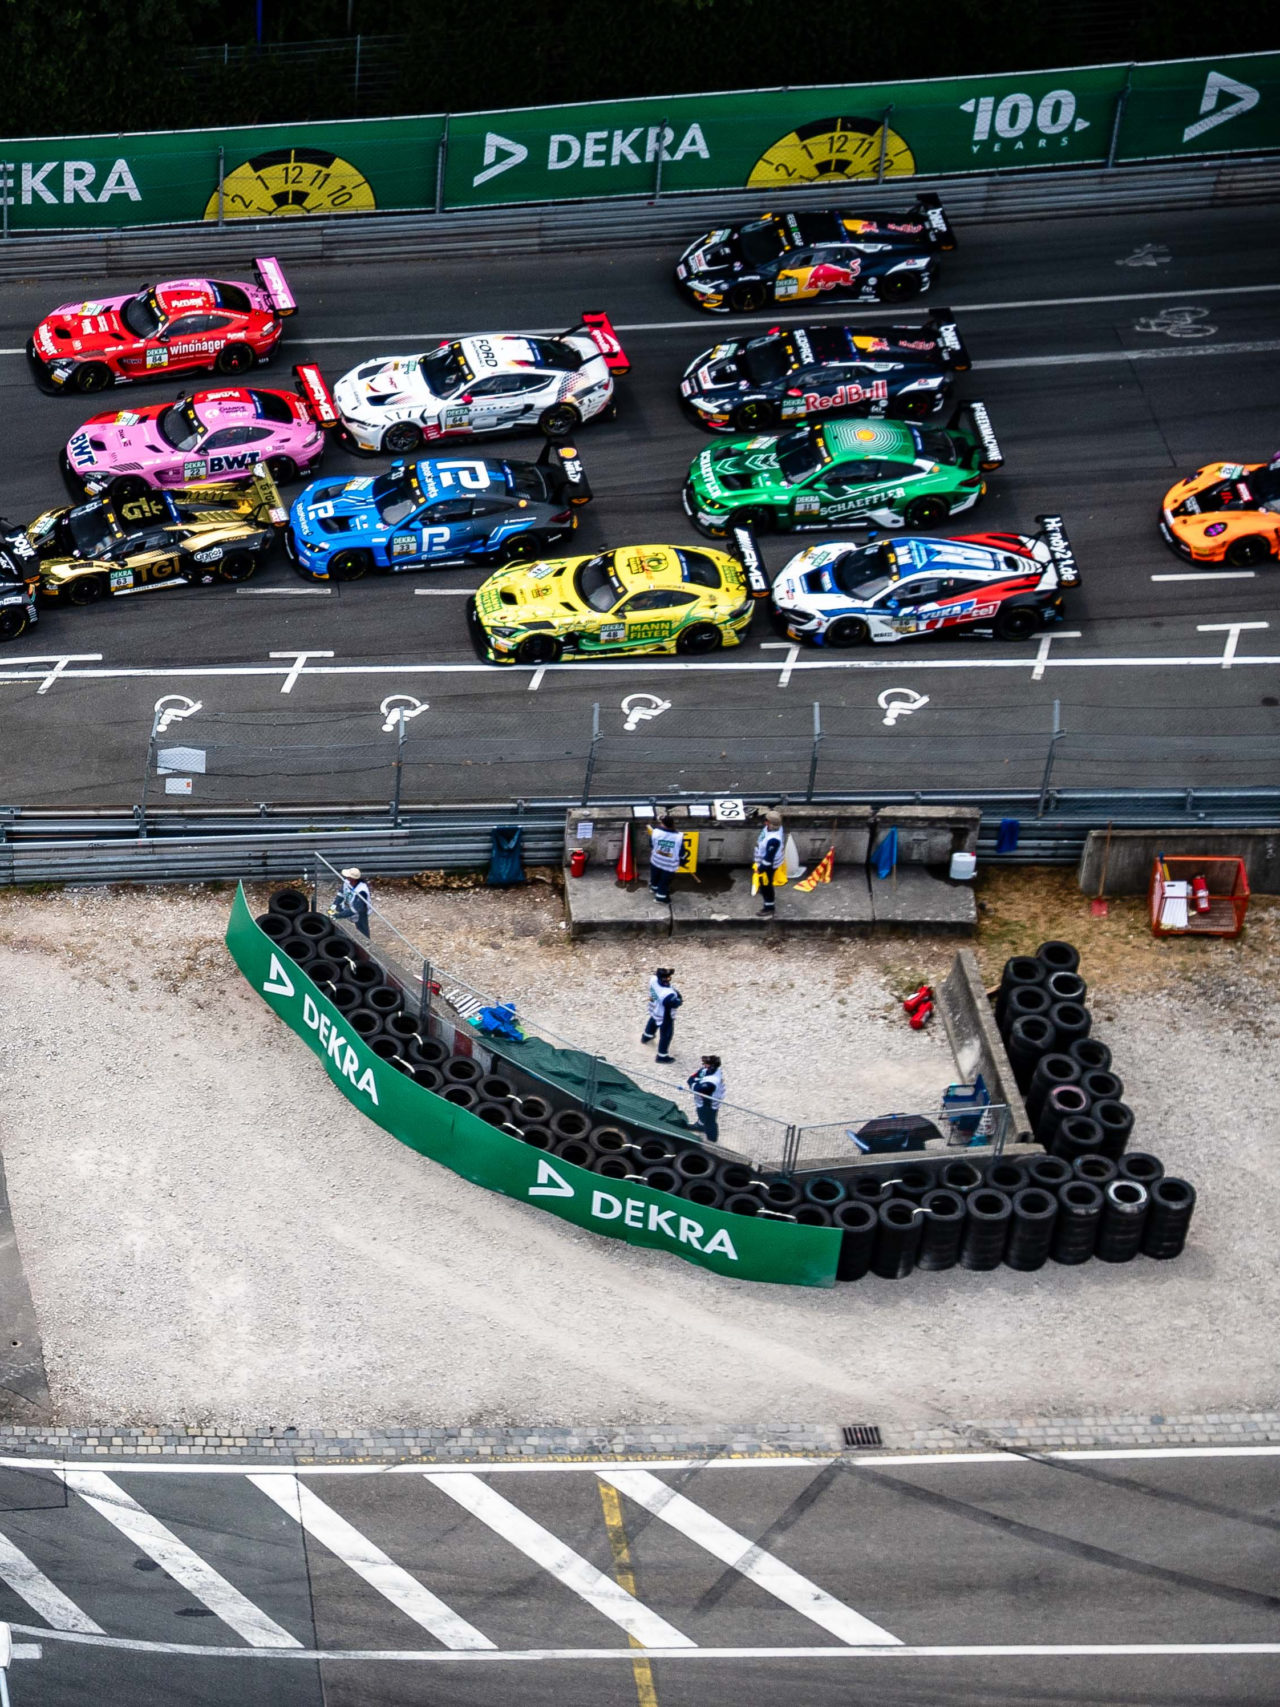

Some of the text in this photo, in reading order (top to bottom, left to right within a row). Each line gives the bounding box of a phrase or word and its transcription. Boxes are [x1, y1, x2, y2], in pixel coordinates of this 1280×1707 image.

[973, 89, 1076, 140] 100
[547, 122, 711, 171] DEKRA
[828, 134, 848, 152] 12
[854, 138, 873, 157] 11
[972, 137, 1068, 154] YEARS
[281, 165, 304, 185] 12
[309, 169, 332, 189] 11
[326, 184, 353, 206] 10
[147, 348, 167, 357] DEKRA
[476, 339, 499, 368] FORD
[315, 390, 335, 420] AMG
[805, 379, 888, 412] Red Bull
[447, 407, 469, 416] DEKRA
[70, 432, 98, 467] BWT
[184, 461, 206, 469] DEKRA
[209, 451, 260, 473] BWT
[700, 450, 721, 499] SCHAEFFLER
[820, 487, 906, 516] SCHAEFFLER
[393, 536, 417, 544] DEKRA
[399, 544, 410, 552] 33
[111, 569, 132, 578] DEKRA
[134, 558, 181, 582] TGI
[744, 552, 766, 590] AMG
[601, 624, 624, 632] DEKRA
[630, 623, 670, 632] MANN
[630, 630, 670, 639] FILTER
[302, 993, 380, 1107] DEKRA
[591, 1190, 739, 1260] DEKRA
